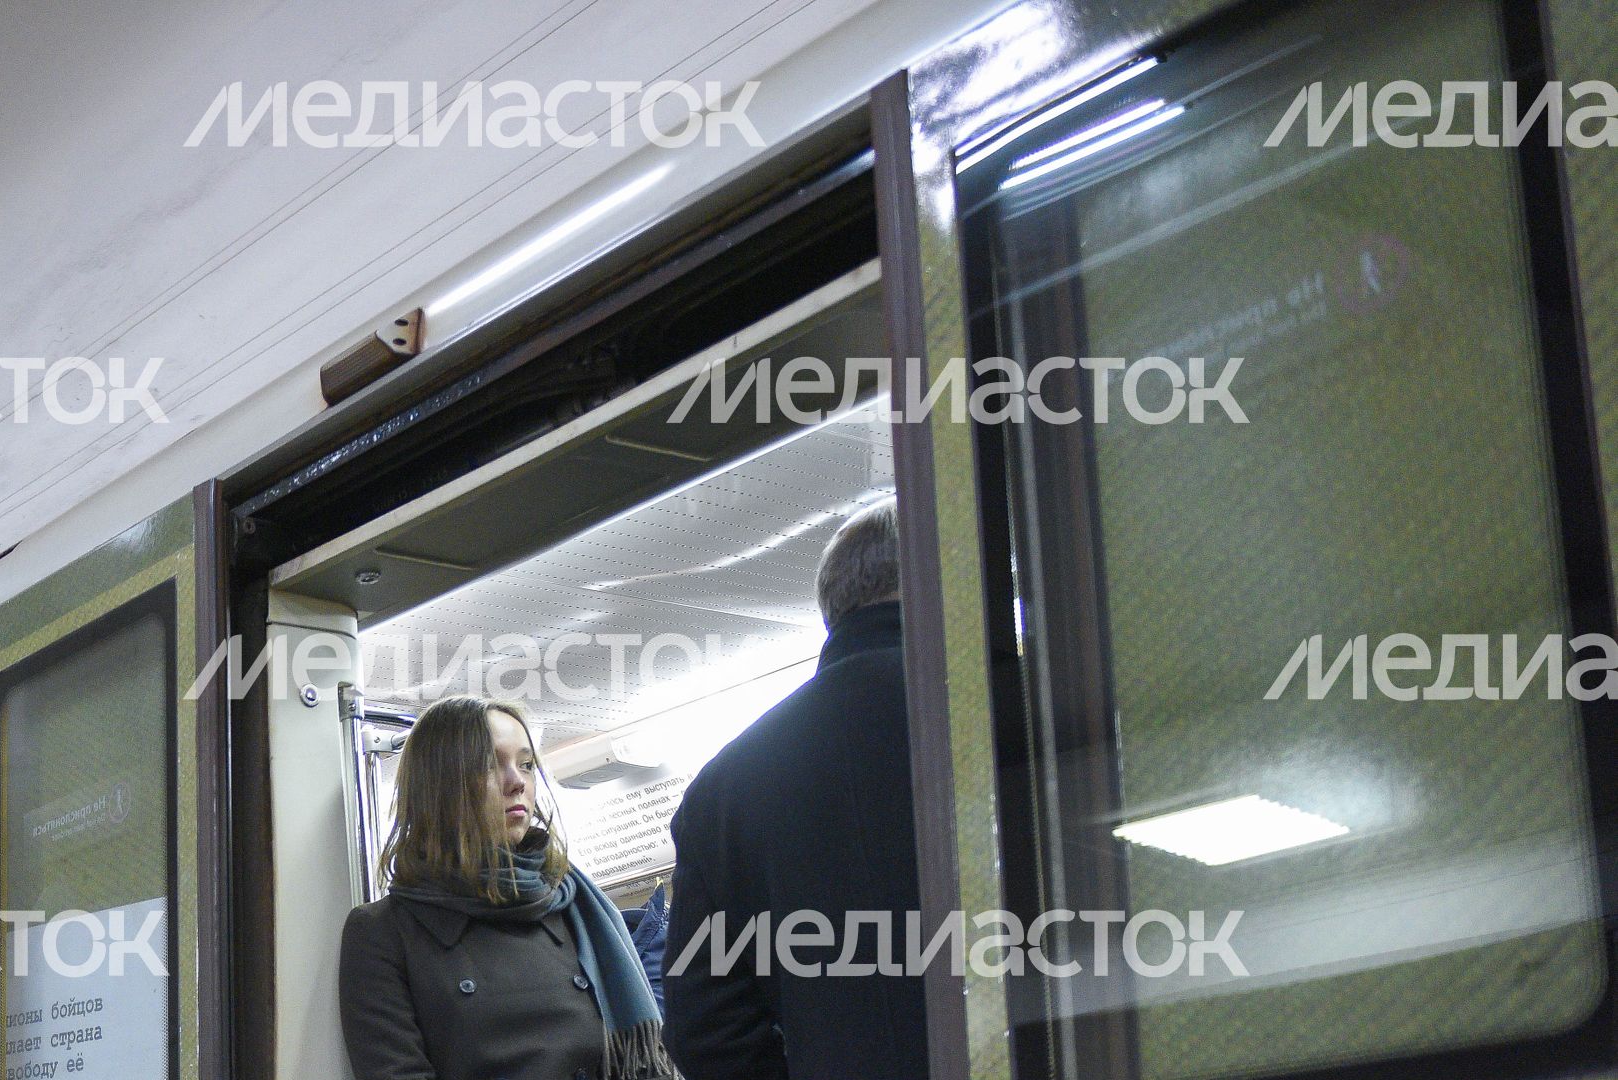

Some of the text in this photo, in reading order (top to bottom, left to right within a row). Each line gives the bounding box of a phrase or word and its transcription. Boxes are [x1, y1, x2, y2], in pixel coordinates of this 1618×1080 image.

[644, 777, 685, 795] выступать
[638, 795, 671, 811] полянах
[642, 814, 654, 823] Он
[619, 826, 662, 845] одинаково
[51, 997, 103, 1020] бойцов
[51, 1025, 103, 1051] страна
[67, 1053, 84, 1073] её
